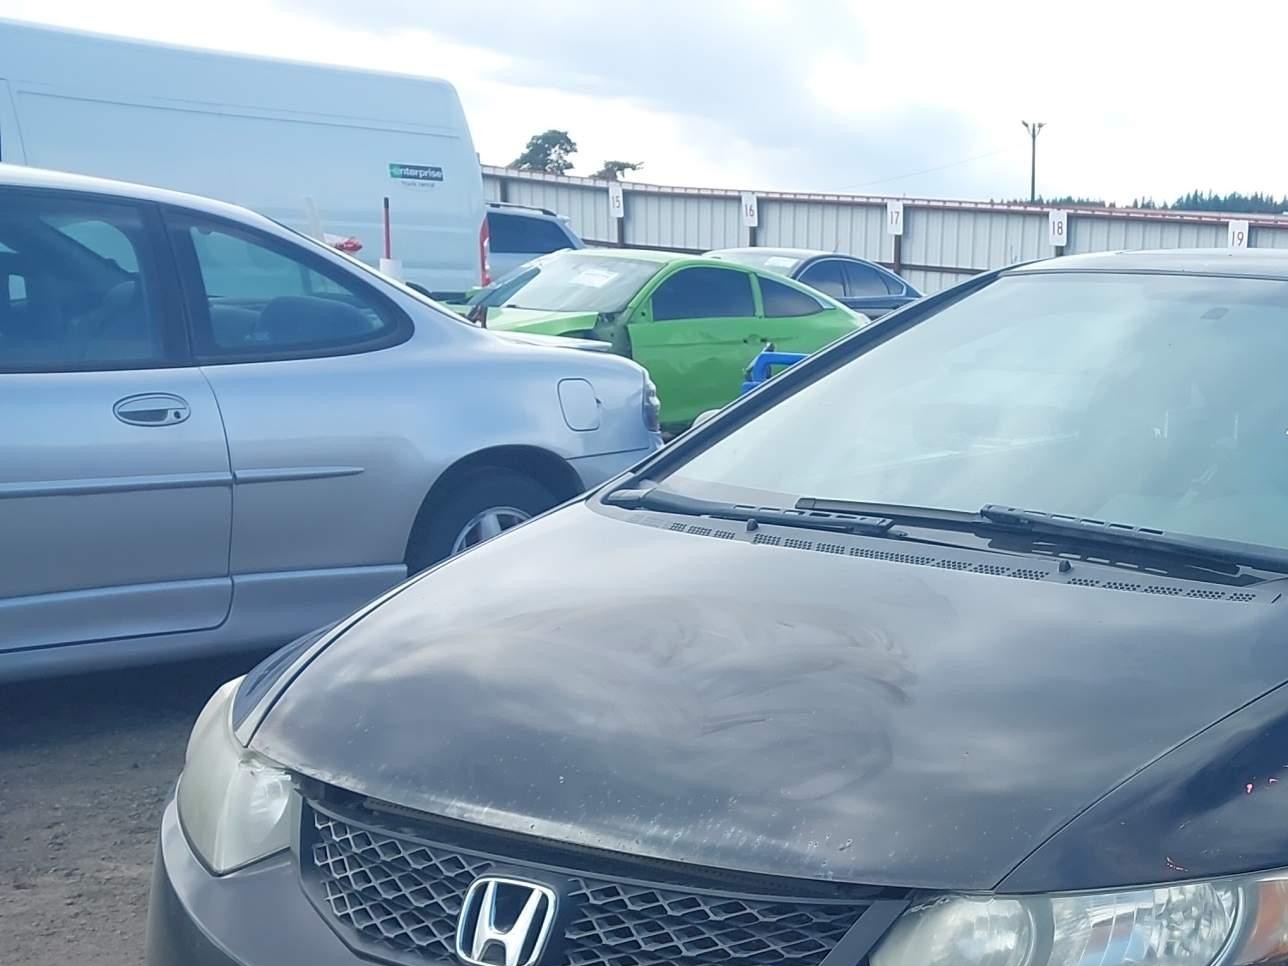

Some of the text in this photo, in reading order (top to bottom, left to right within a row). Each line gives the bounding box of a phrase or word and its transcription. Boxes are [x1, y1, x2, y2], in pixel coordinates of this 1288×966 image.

[391, 166, 442, 179] enterprise
[611, 195, 621, 209] 15
[744, 203, 756, 218] 16
[889, 210, 901, 225] 17
[1052, 220, 1064, 236] 18
[1231, 231, 1245, 247] 19
